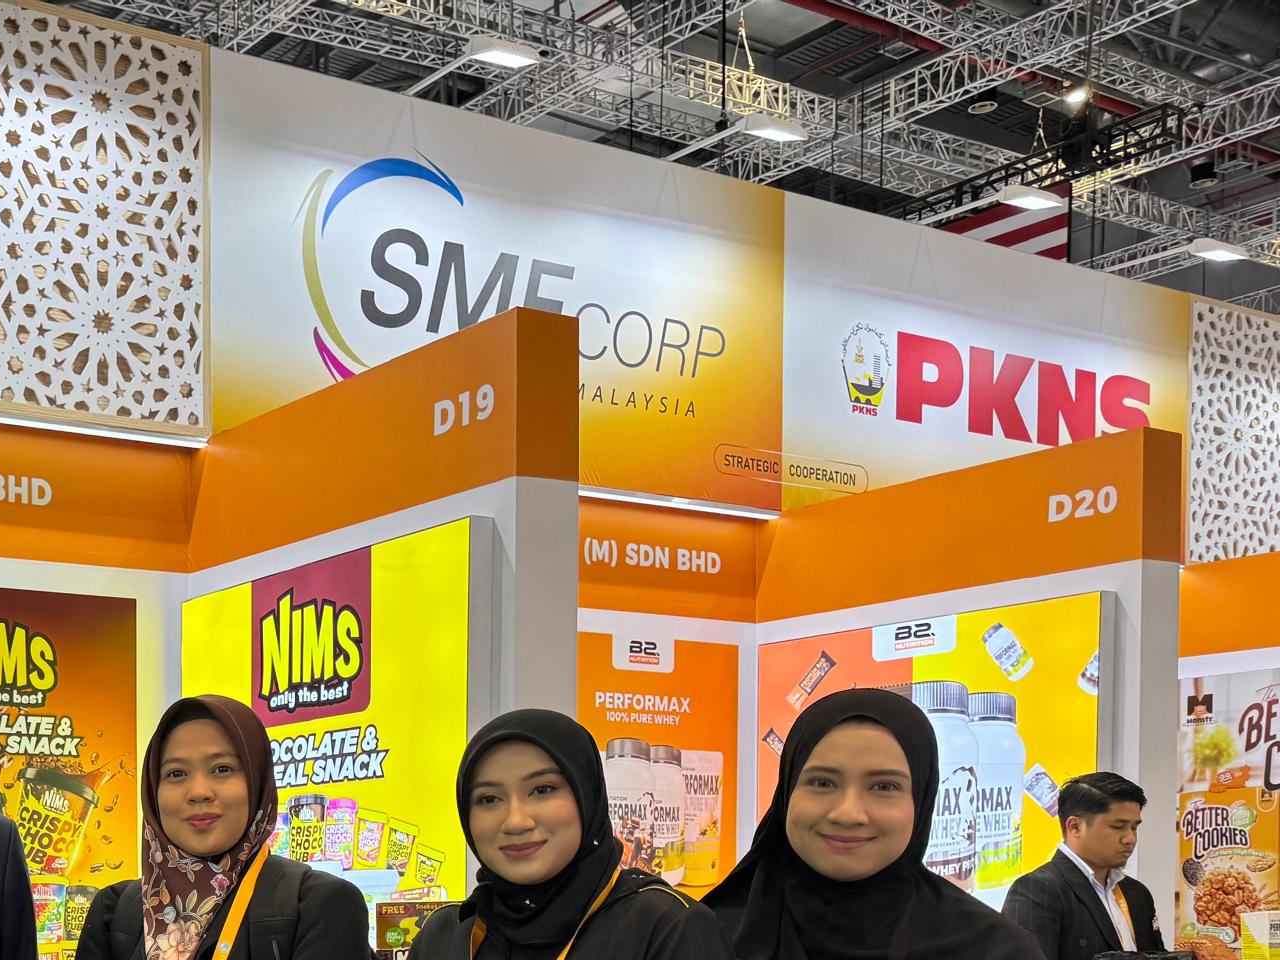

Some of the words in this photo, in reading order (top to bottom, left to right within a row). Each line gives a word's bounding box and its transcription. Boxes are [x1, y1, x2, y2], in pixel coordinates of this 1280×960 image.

[577, 302, 726, 379] CORP
[895, 330, 1151, 447] PKNS
[433, 384, 495, 436] D19
[852, 404, 878, 416] PKNS
[723, 453, 780, 475] STRATEGIC
[788, 464, 857, 488] COOPERATION
[1048, 487, 1117, 523] D20
[583, 540, 618, 568] (M)
[625, 544, 670, 571] SDN
[676, 547, 721, 574] BHD
[262, 594, 360, 697] NIMS
[895, 637, 934, 650] NUTRITION
[13, 690, 44, 705] best
[270, 691, 295, 708] only
[298, 688, 318, 702] the
[320, 682, 349, 701] best
[595, 692, 691, 713] PERFORMAX
[57, 717, 73, 736] &
[606, 711, 629, 722] 100%
[631, 713, 653, 724] PURE
[654, 714, 680, 725] WHEY
[5, 736, 81, 756] SNACK
[270, 729, 360, 763] OCOLATE
[361, 726, 377, 751] &
[274, 766, 308, 787] EAL
[311, 750, 388, 784] SNACK
[682, 774, 719, 795] RFORMAX
[43, 789, 70, 812] NIMS
[609, 803, 648, 820] RFORMAX
[653, 806, 680, 822] ORMAX
[19, 806, 81, 838] CRISPY
[290, 824, 323, 838] CRISPY
[326, 824, 352, 834] CRISPY
[983, 812, 1011, 832] WHEY
[1182, 806, 1230, 838] BETTER
[290, 837, 323, 851] CHOCO
[325, 833, 352, 842] CHOCO
[325, 842, 341, 851] TUB
[390, 839, 410, 851] CRISPY
[1194, 827, 1249, 860] COOKIES
[25, 846, 48, 865] UB
[290, 850, 309, 862] TUB
[927, 863, 961, 877] WHEY
[66, 906, 89, 915] CRISP
[66, 914, 84, 923] CHO
[382, 905, 405, 915] FREE
[66, 923, 83, 931] TUB
